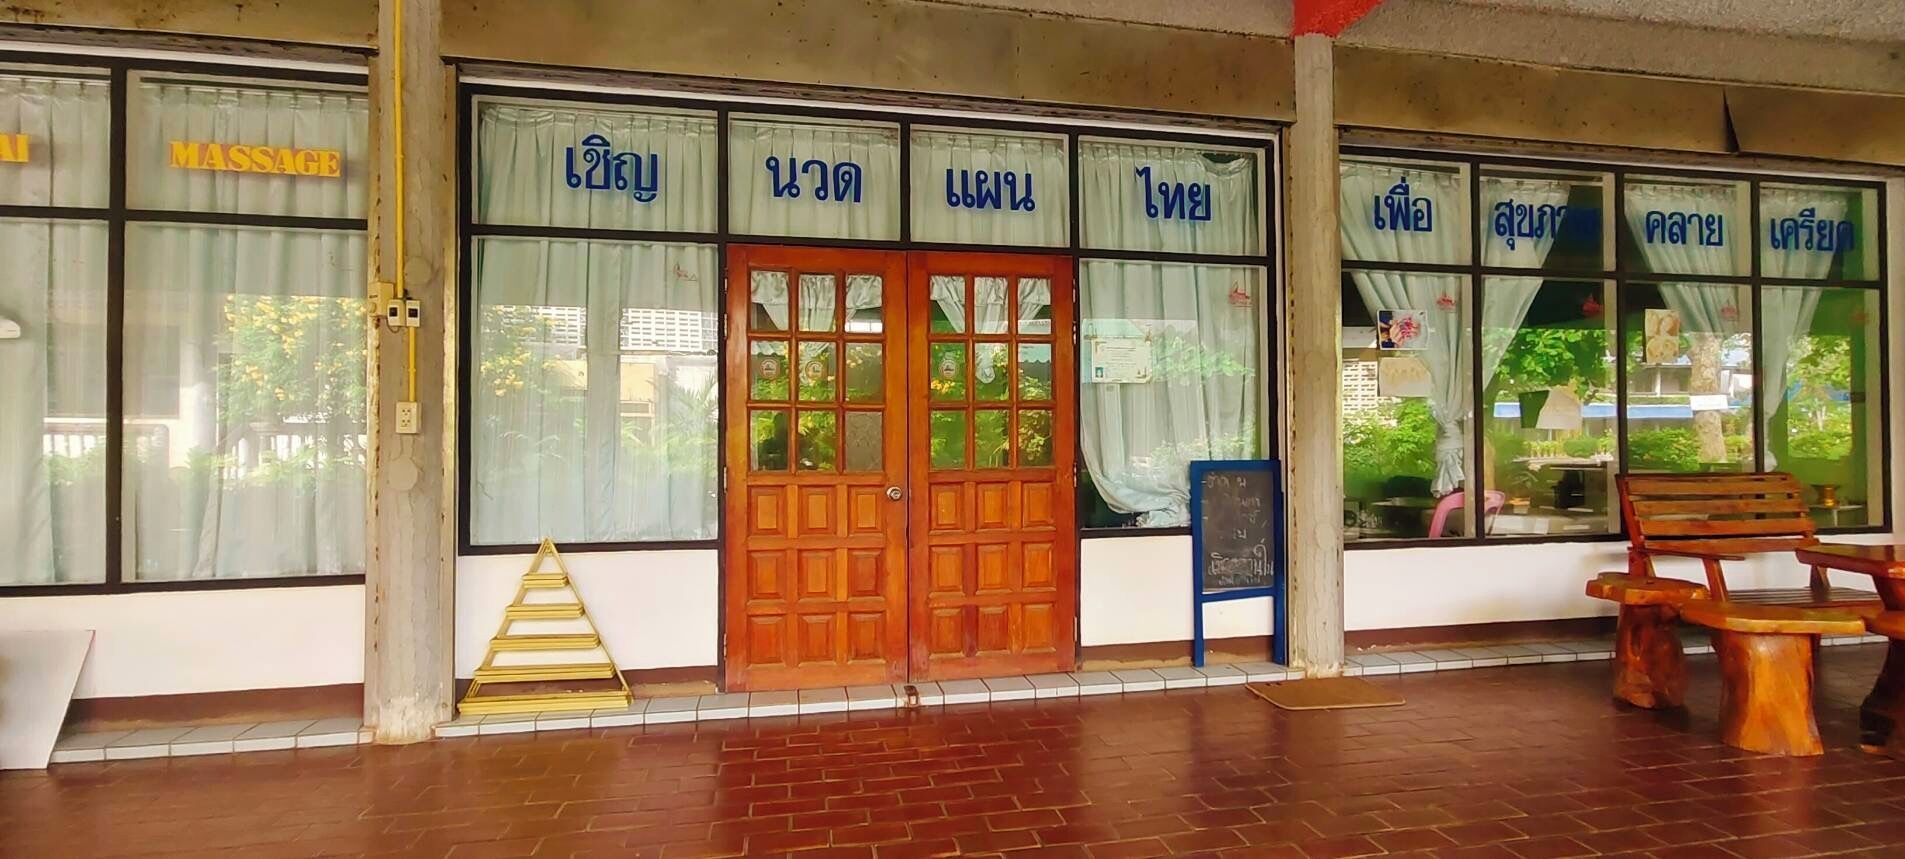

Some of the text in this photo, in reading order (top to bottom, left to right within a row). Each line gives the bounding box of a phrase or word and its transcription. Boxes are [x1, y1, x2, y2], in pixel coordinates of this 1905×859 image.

[169, 141, 341, 177] MASSAGE
[565, 134, 1212, 221] เชิญ นวด แผน ไทย
[1373, 176, 1433, 232] เพื่อ
[1494, 198, 1601, 251] สุขภา
[1645, 210, 1724, 246] คลาย
